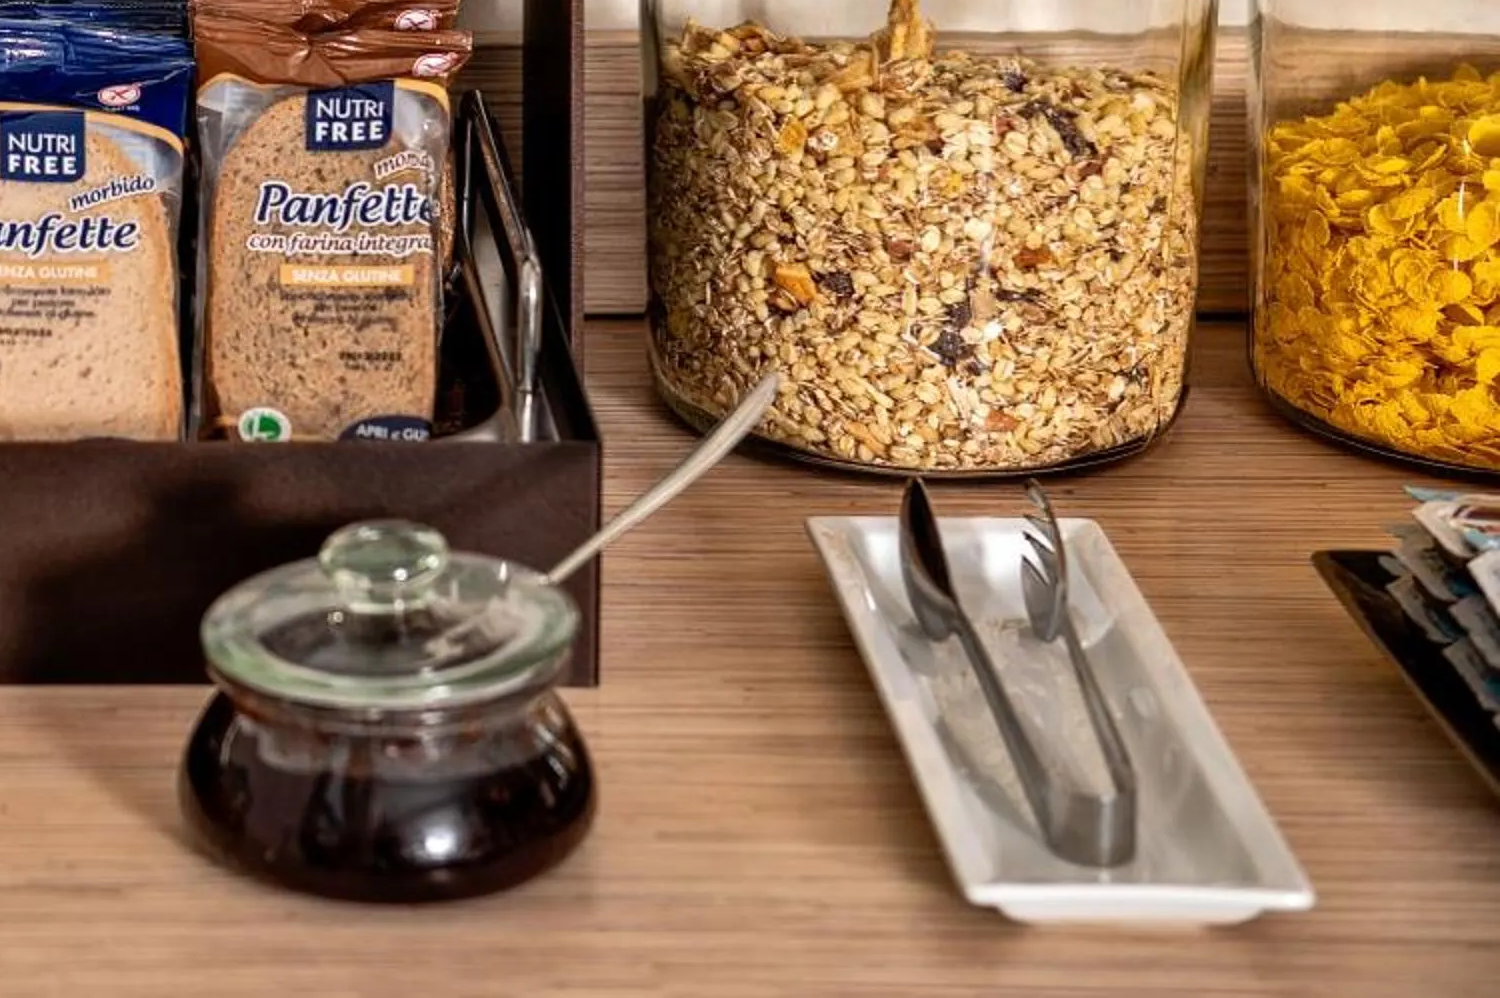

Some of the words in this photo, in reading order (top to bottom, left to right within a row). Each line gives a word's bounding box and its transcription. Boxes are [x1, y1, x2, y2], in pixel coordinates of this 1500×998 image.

[316, 98, 383, 118] NUTRI
[316, 123, 383, 141] FREE
[8, 133, 76, 152] NUTRI
[8, 155, 77, 175] FREE
[70, 176, 155, 209] morbido
[250, 236, 283, 248] con
[286, 235, 350, 253] farina
[359, 235, 432, 254] integra
[39, 265, 98, 279] GLUTINE
[291, 269, 339, 282] SENZA
[343, 269, 403, 282] GLUTINE
